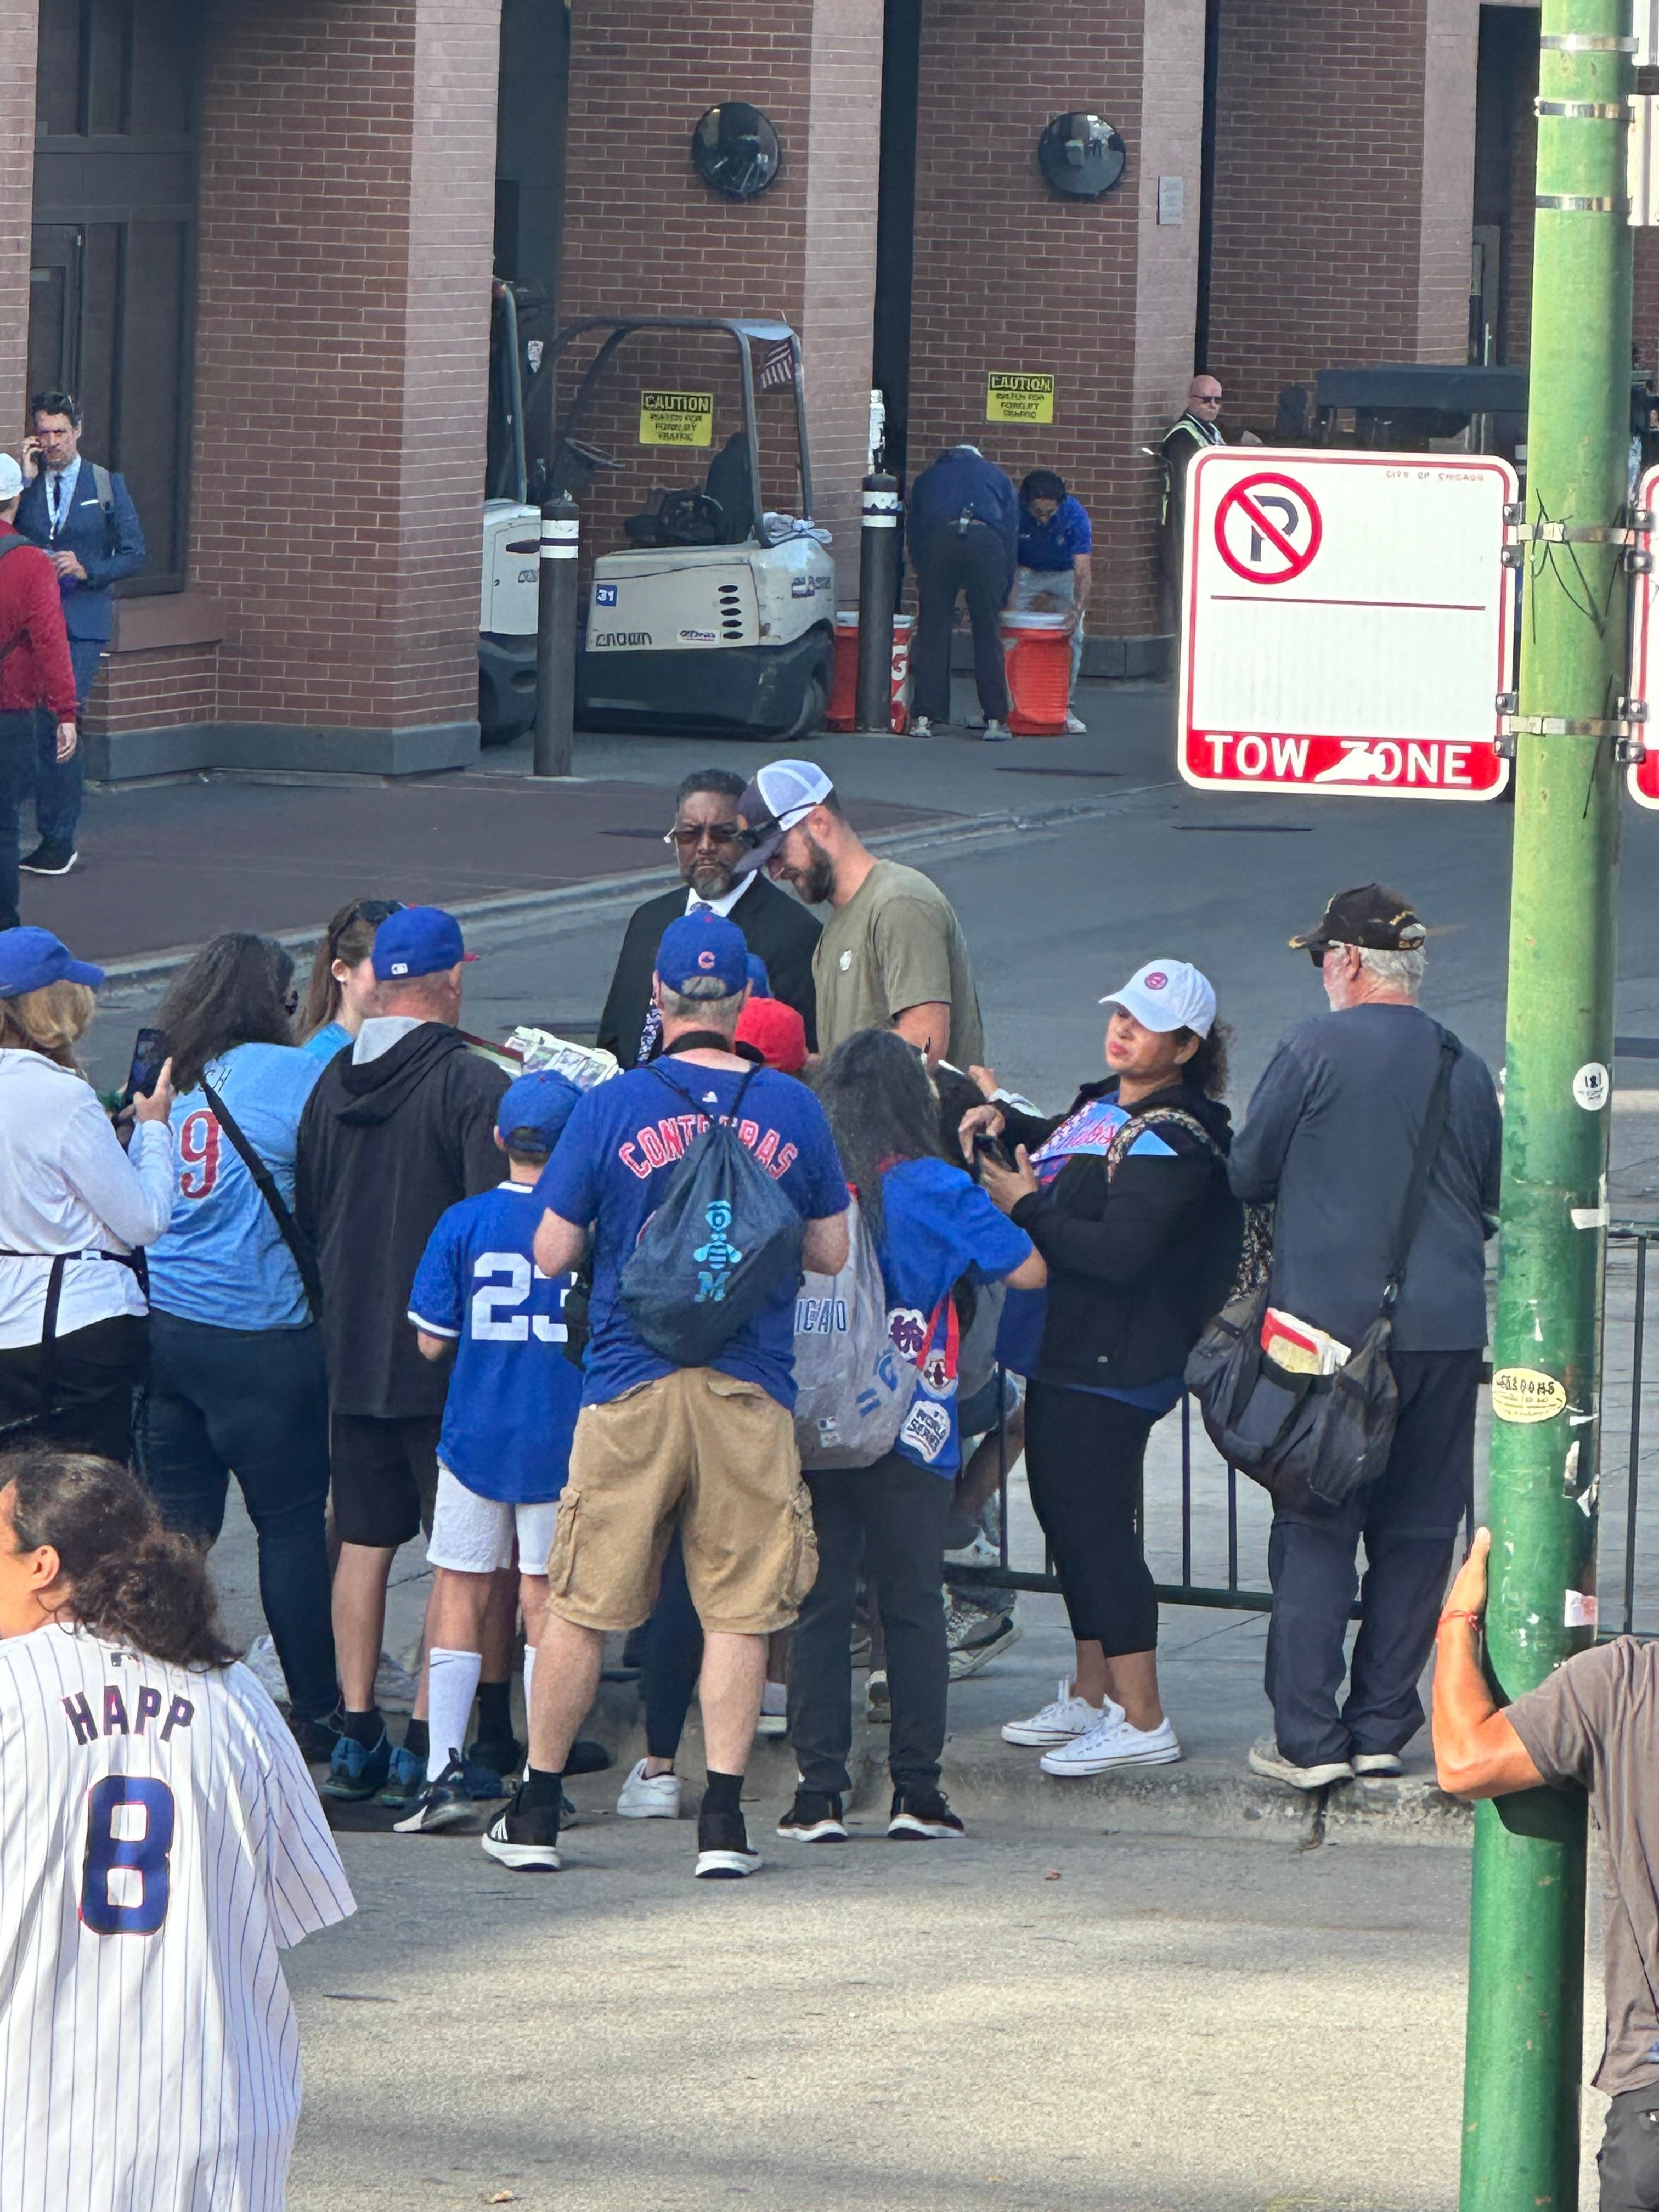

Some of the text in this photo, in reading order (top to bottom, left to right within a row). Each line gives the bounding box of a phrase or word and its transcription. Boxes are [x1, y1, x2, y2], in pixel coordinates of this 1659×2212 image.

[991, 376, 1051, 391] CAUTION
[644, 395, 709, 411] CAUTION
[1204, 734, 1310, 778] TOW
[698, 951, 715, 969] C
[62, 1685, 195, 1746] HAPP
[78, 1775, 176, 1936] 8
